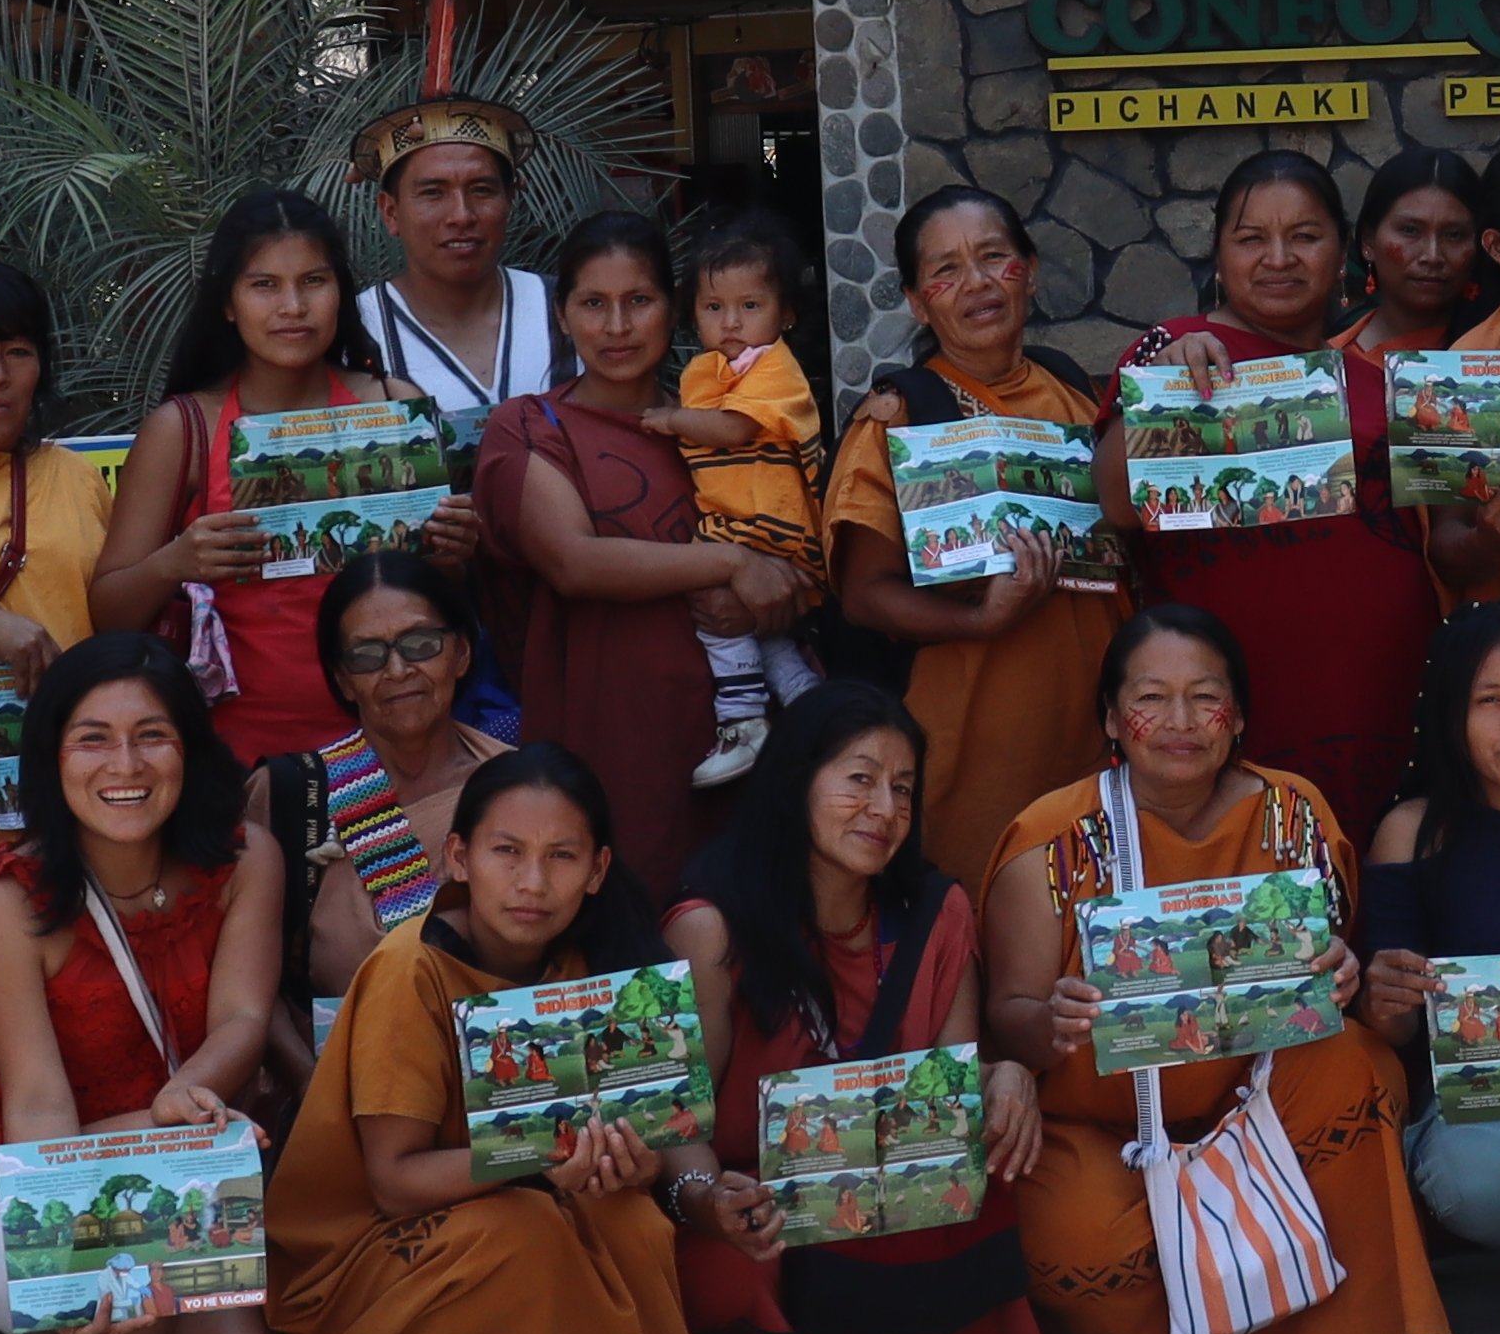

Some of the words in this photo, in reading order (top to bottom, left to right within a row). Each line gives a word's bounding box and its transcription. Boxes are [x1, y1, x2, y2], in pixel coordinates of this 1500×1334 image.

[1056, 87, 1361, 125] PICHANAKI
[1246, 369, 1303, 385] YANESHA
[338, 420, 348, 431] Y
[350, 414, 407, 429] YANESHA
[307, 779, 319, 807] PINK
[306, 819, 318, 847] PINK
[45, 1156, 53, 1165] Y
[56, 1153, 77, 1164] LAS
[132, 1144, 156, 1155] NOS
[184, 1299, 201, 1309] YO
[203, 1296, 217, 1307] ME
[219, 1292, 264, 1306] VACUNO
